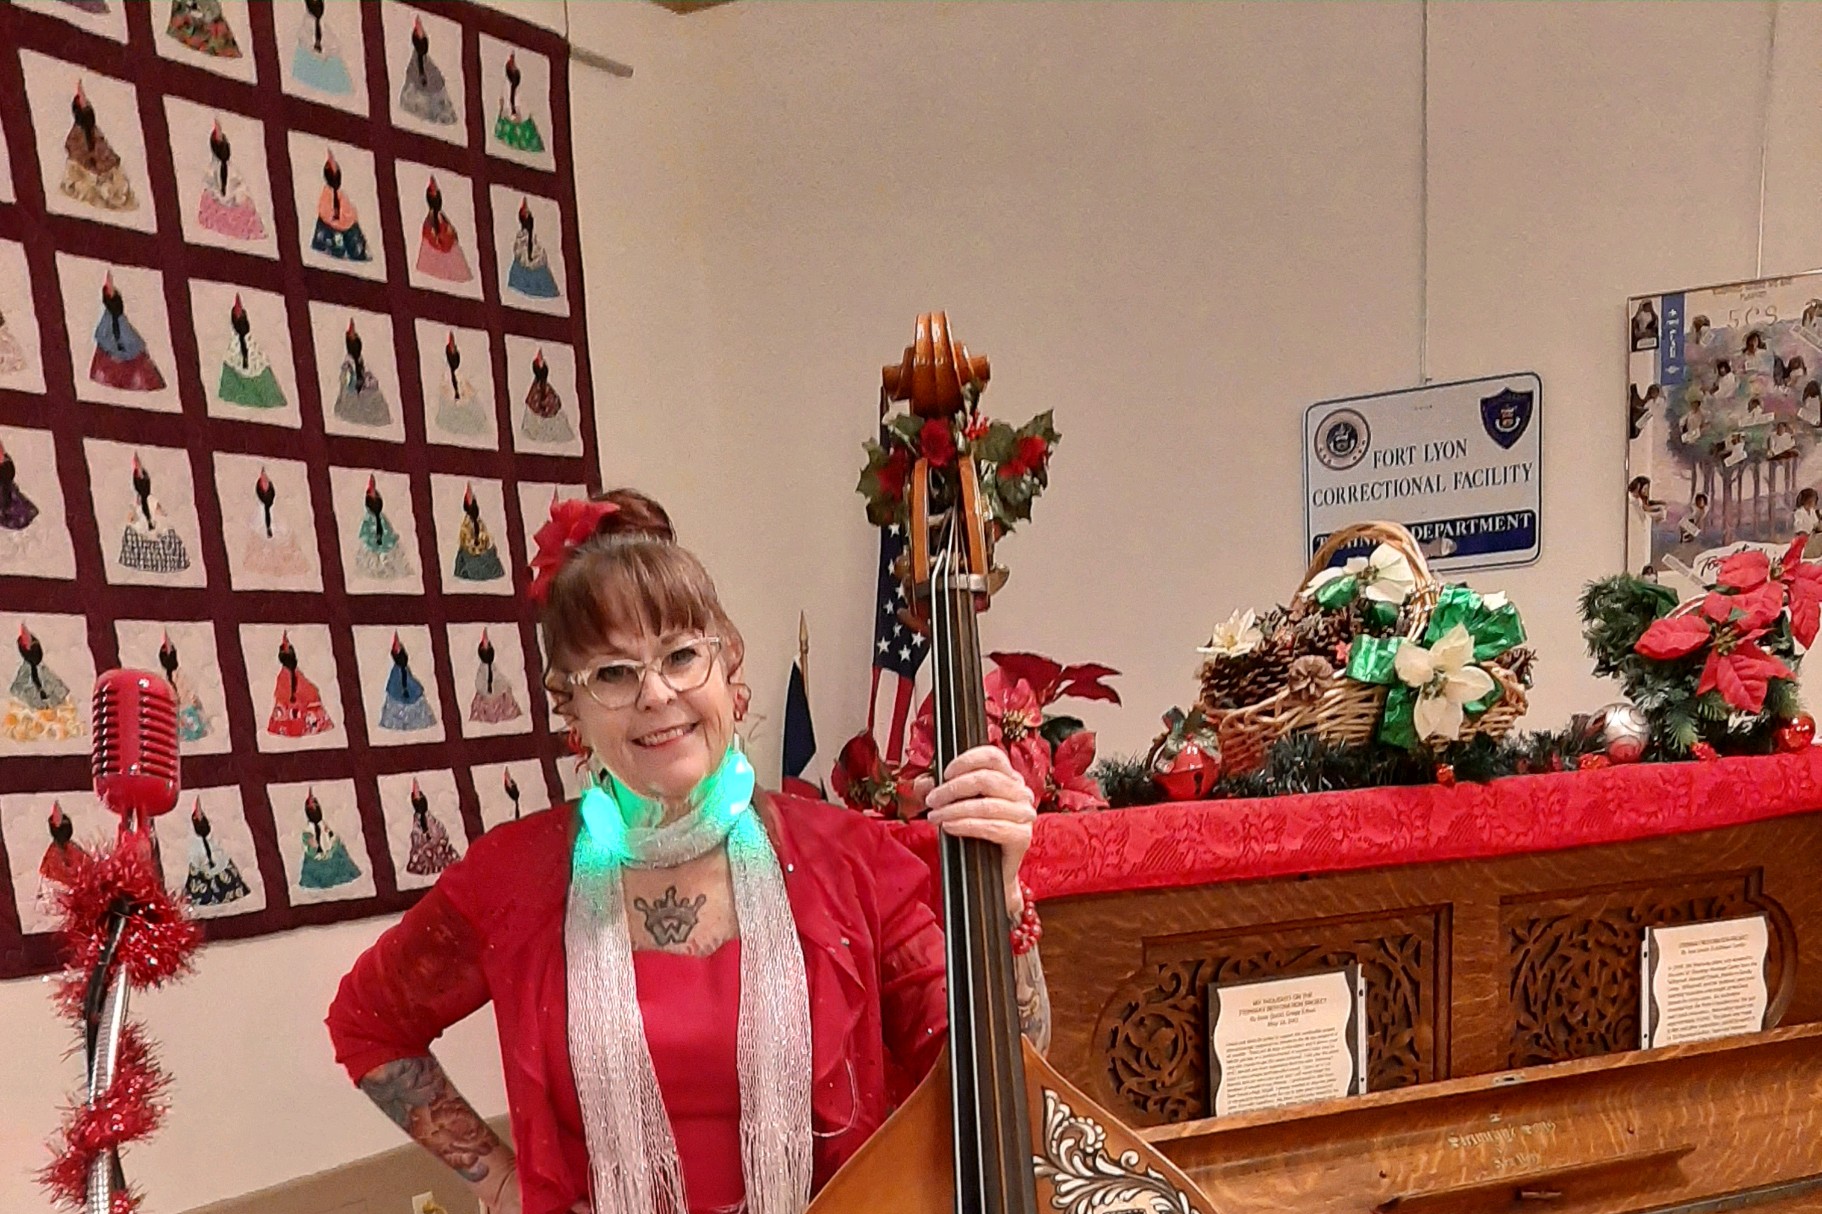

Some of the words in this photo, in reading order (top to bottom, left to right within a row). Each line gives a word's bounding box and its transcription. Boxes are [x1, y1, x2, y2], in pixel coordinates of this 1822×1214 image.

[1373, 445, 1417, 469] FORT
[1423, 438, 1468, 463] LYON
[1312, 473, 1446, 507] CORRECTIONAL
[1453, 462, 1534, 490] FACILITY
[1411, 512, 1533, 541] DEPARTMENT
